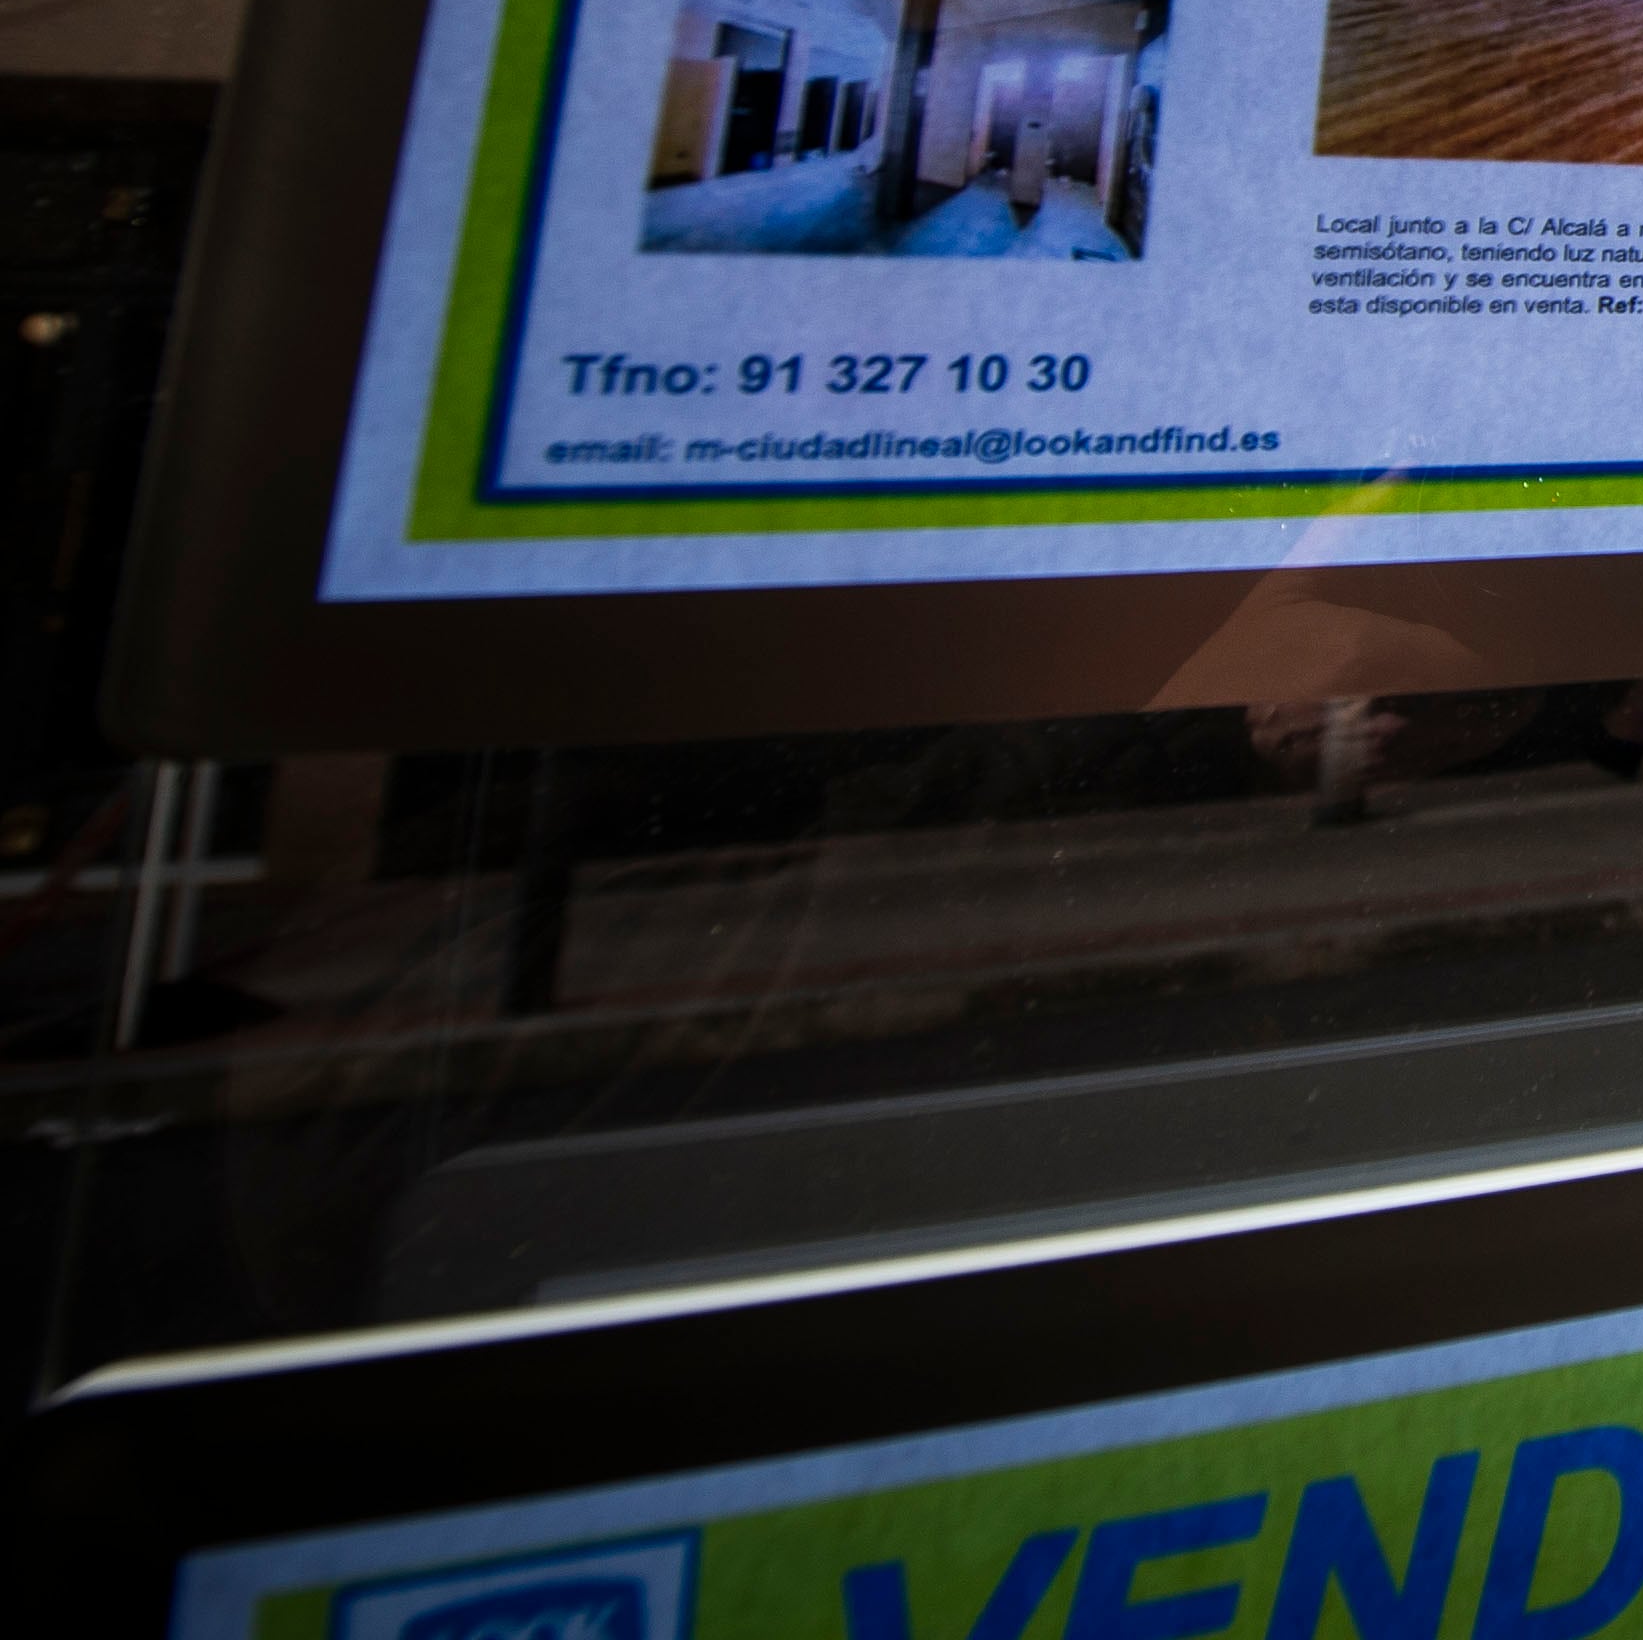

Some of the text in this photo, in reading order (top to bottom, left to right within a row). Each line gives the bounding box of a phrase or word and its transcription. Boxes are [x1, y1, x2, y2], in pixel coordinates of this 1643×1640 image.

[1317, 215, 1379, 234] Local
[1389, 216, 1445, 238] junto
[1454, 220, 1469, 235] a
[1478, 217, 1498, 235] la
[1507, 217, 1533, 236] C/
[1541, 218, 1607, 237] Alcalá
[1616, 223, 1630, 237] a
[1314, 242, 1452, 263] semisótano,
[1462, 244, 1557, 262] teniendo
[1563, 244, 1595, 263] luz
[1312, 269, 1435, 287] ventilación
[1444, 273, 1458, 291] y
[1466, 273, 1493, 288] se
[1501, 271, 1611, 289] encuentra
[1309, 297, 1360, 314] esta
[1366, 295, 1483, 316] disponible
[1489, 299, 1517, 314] en
[1524, 297, 1589, 314] venta.
[1598, 295, 1643, 314] Ref:
[561, 351, 1092, 397] Tfno: 91 327 10 30
[543, 426, 1283, 468] email: m-ciudadlineal@lookandfind.es
